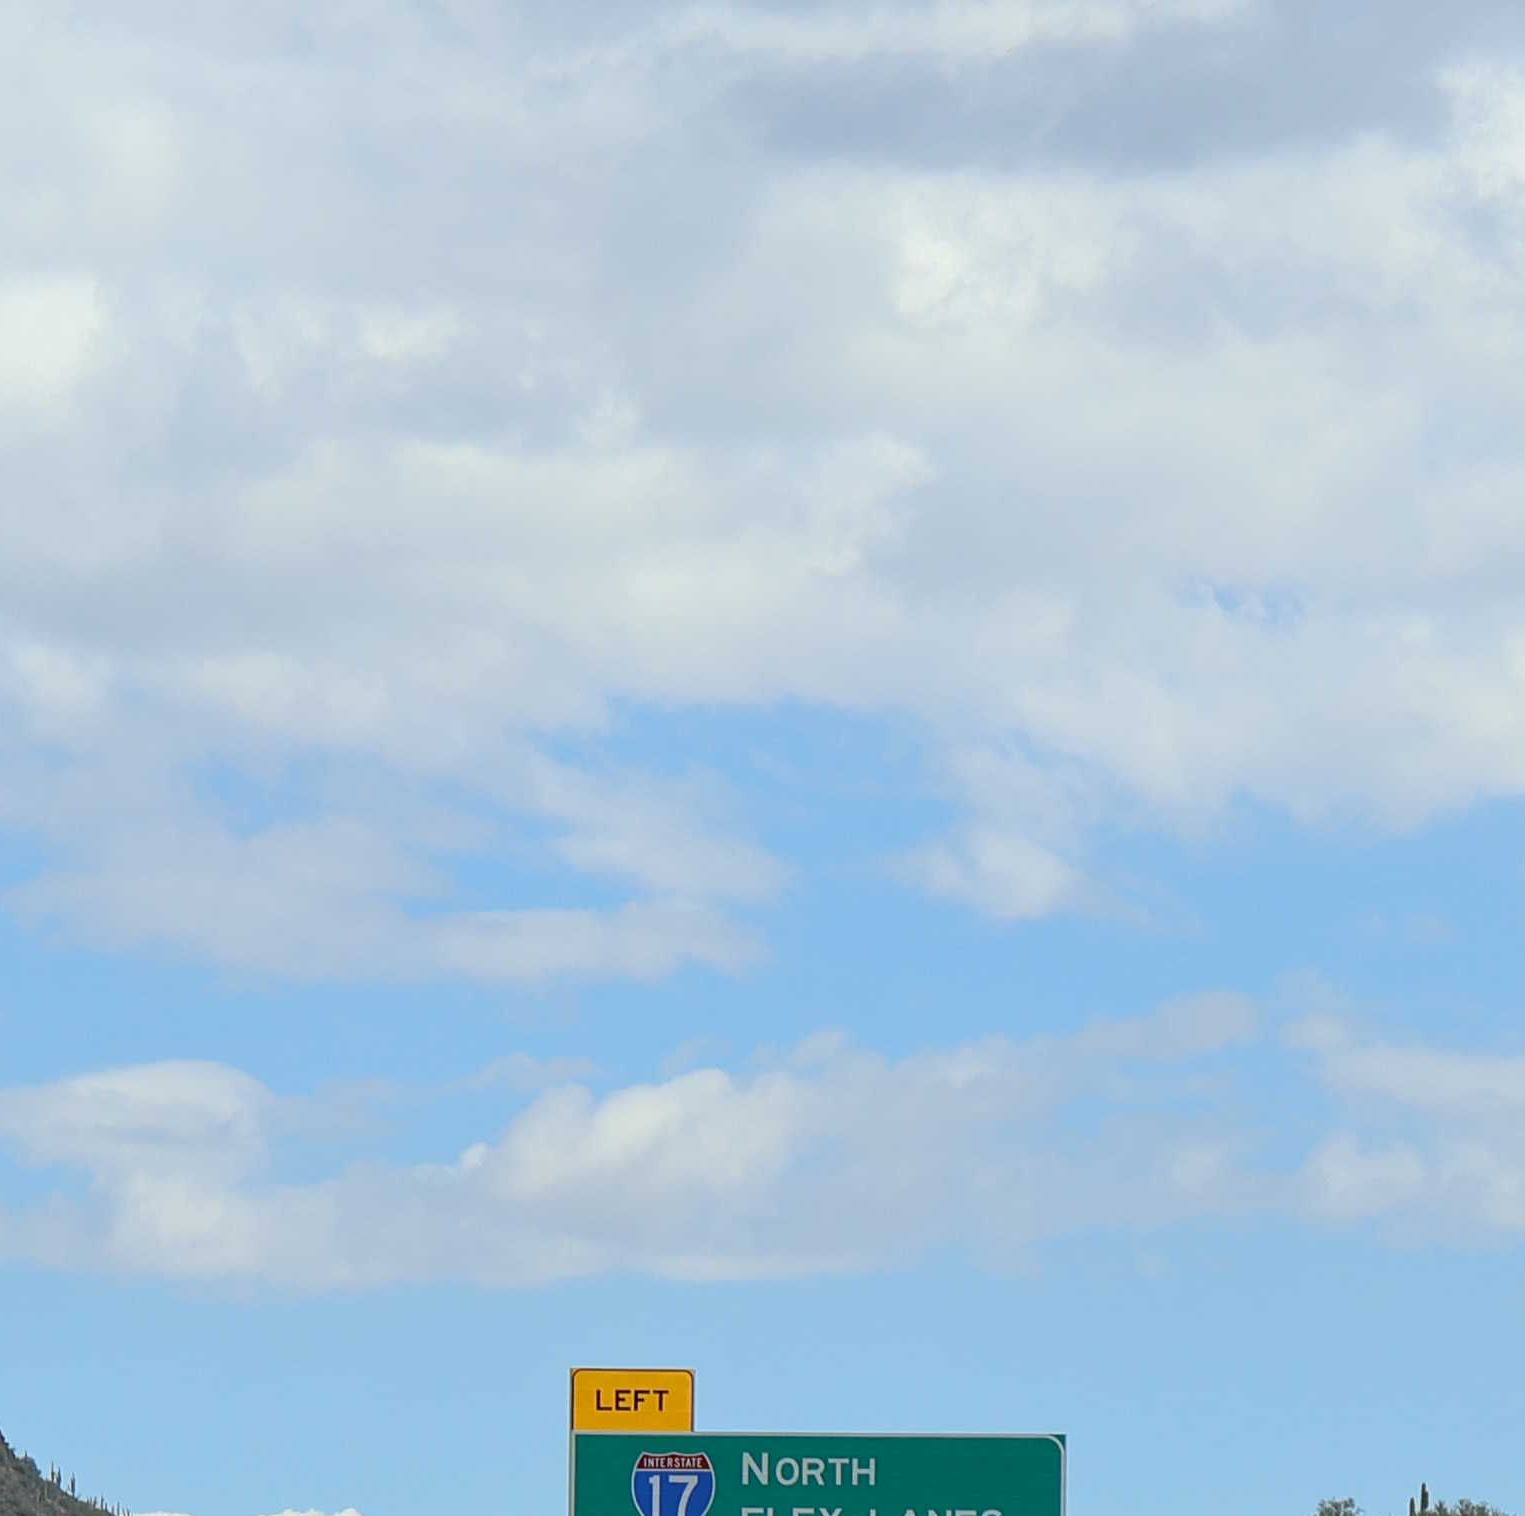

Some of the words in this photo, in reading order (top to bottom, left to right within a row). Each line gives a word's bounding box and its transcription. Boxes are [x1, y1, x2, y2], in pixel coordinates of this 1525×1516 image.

[596, 1389, 669, 1411] LEFT
[643, 1457, 703, 1468] INTERSTATE
[742, 1452, 876, 1486] NORTH
